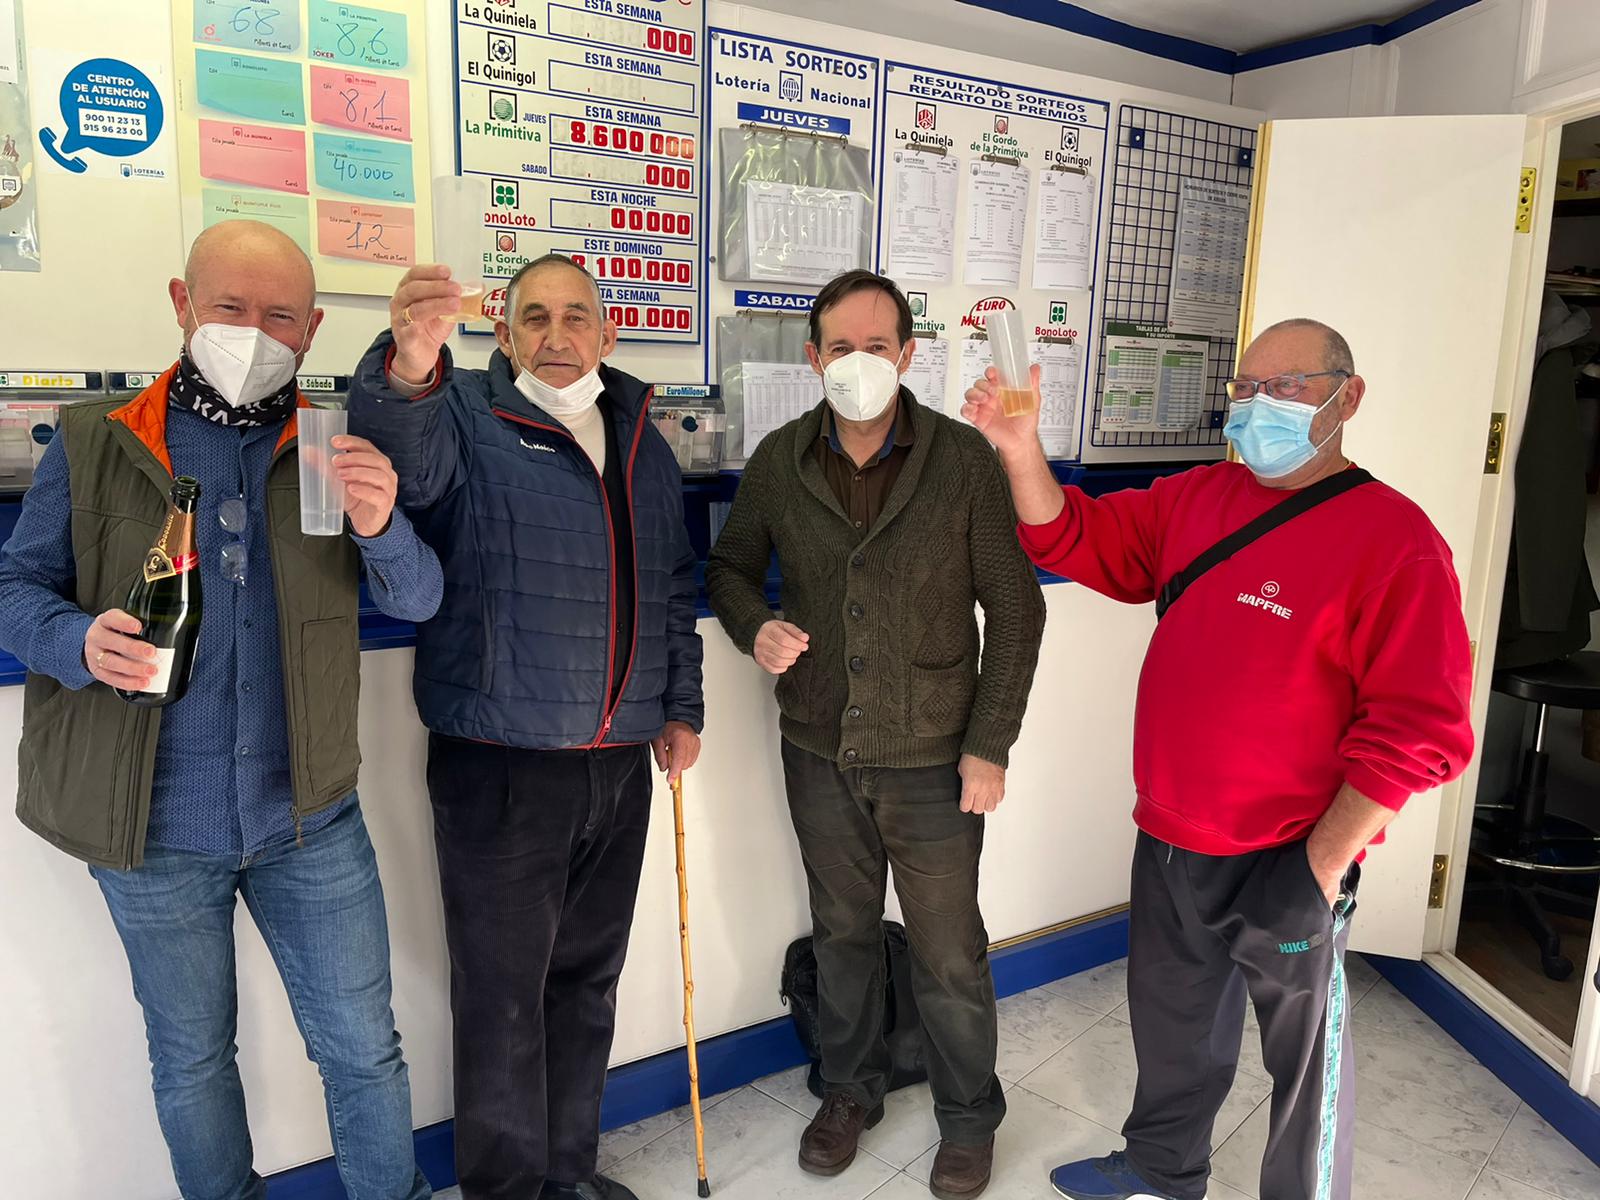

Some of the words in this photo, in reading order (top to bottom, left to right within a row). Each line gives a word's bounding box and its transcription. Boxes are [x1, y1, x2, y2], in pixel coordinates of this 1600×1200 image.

[464, 2, 480, 20] La
[483, 6, 538, 31] Quiniela
[584, 0, 613, 13] ESTA
[616, 2, 663, 23] SEMANA
[228, 7, 281, 36] 68
[312, 50, 334, 59] JOKER
[720, 38, 774, 64] LISTA
[785, 50, 868, 80] SORTEOS
[584, 52, 613, 67] ESTA
[616, 57, 663, 77] SEMANA
[87, 73, 135, 88] CENTRO
[468, 61, 480, 76] El
[483, 63, 537, 87] Quinigol
[72, 82, 89, 93] DE
[91, 86, 150, 99] ATENCIÓN
[715, 72, 770, 93] Lotería
[810, 90, 871, 109] Nacional
[912, 73, 1011, 100] RESULTADO
[1015, 93, 1086, 113] SORTEOS
[77, 94, 93, 104] AL
[95, 96, 147, 110] USUARIO
[908, 84, 986, 106] REPARTO
[990, 97, 1014, 110] DE
[1017, 104, 1088, 124] PREMIOS
[85, 113, 105, 122] 900
[107, 115, 115, 123] 11
[117, 116, 129, 125] 23
[131, 118, 141, 126] 13
[522, 112, 548, 125] JUEVES
[585, 105, 613, 120] ESTA
[616, 109, 662, 128] SEMANA
[760, 109, 830, 129] JUEVES
[83, 123, 100, 132] 915
[101, 125, 114, 133] 96
[116, 126, 128, 134] 23
[130, 127, 144, 136] 00
[465, 119, 480, 135] La
[483, 122, 542, 143] Primitiva
[894, 128, 907, 140] La
[910, 130, 954, 148] Quiniela
[982, 132, 991, 142] El
[992, 134, 1018, 147] Gordo
[970, 141, 981, 151] de
[982, 142, 991, 153] la
[992, 144, 1029, 159] Primitiva
[1044, 150, 1053, 162] El
[1055, 153, 1092, 168] Quinigol
[521, 163, 548, 175] SABADO
[590, 189, 619, 203] ESTA
[621, 192, 657, 207] NOCHE
[484, 211, 537, 228] onoLoto
[584, 238, 610, 251] ESTE
[614, 241, 663, 256] DOMINGO
[482, 252, 493, 263] El
[495, 253, 531, 265] Gordo
[483, 264, 494, 274] la
[616, 289, 661, 303] SEMANA
[975, 300, 1006, 312] EURO
[1034, 326, 1078, 338] BonoLoto
[1236, 592, 1293, 620] MAPFRE
[1279, 940, 1310, 954] NIKE
